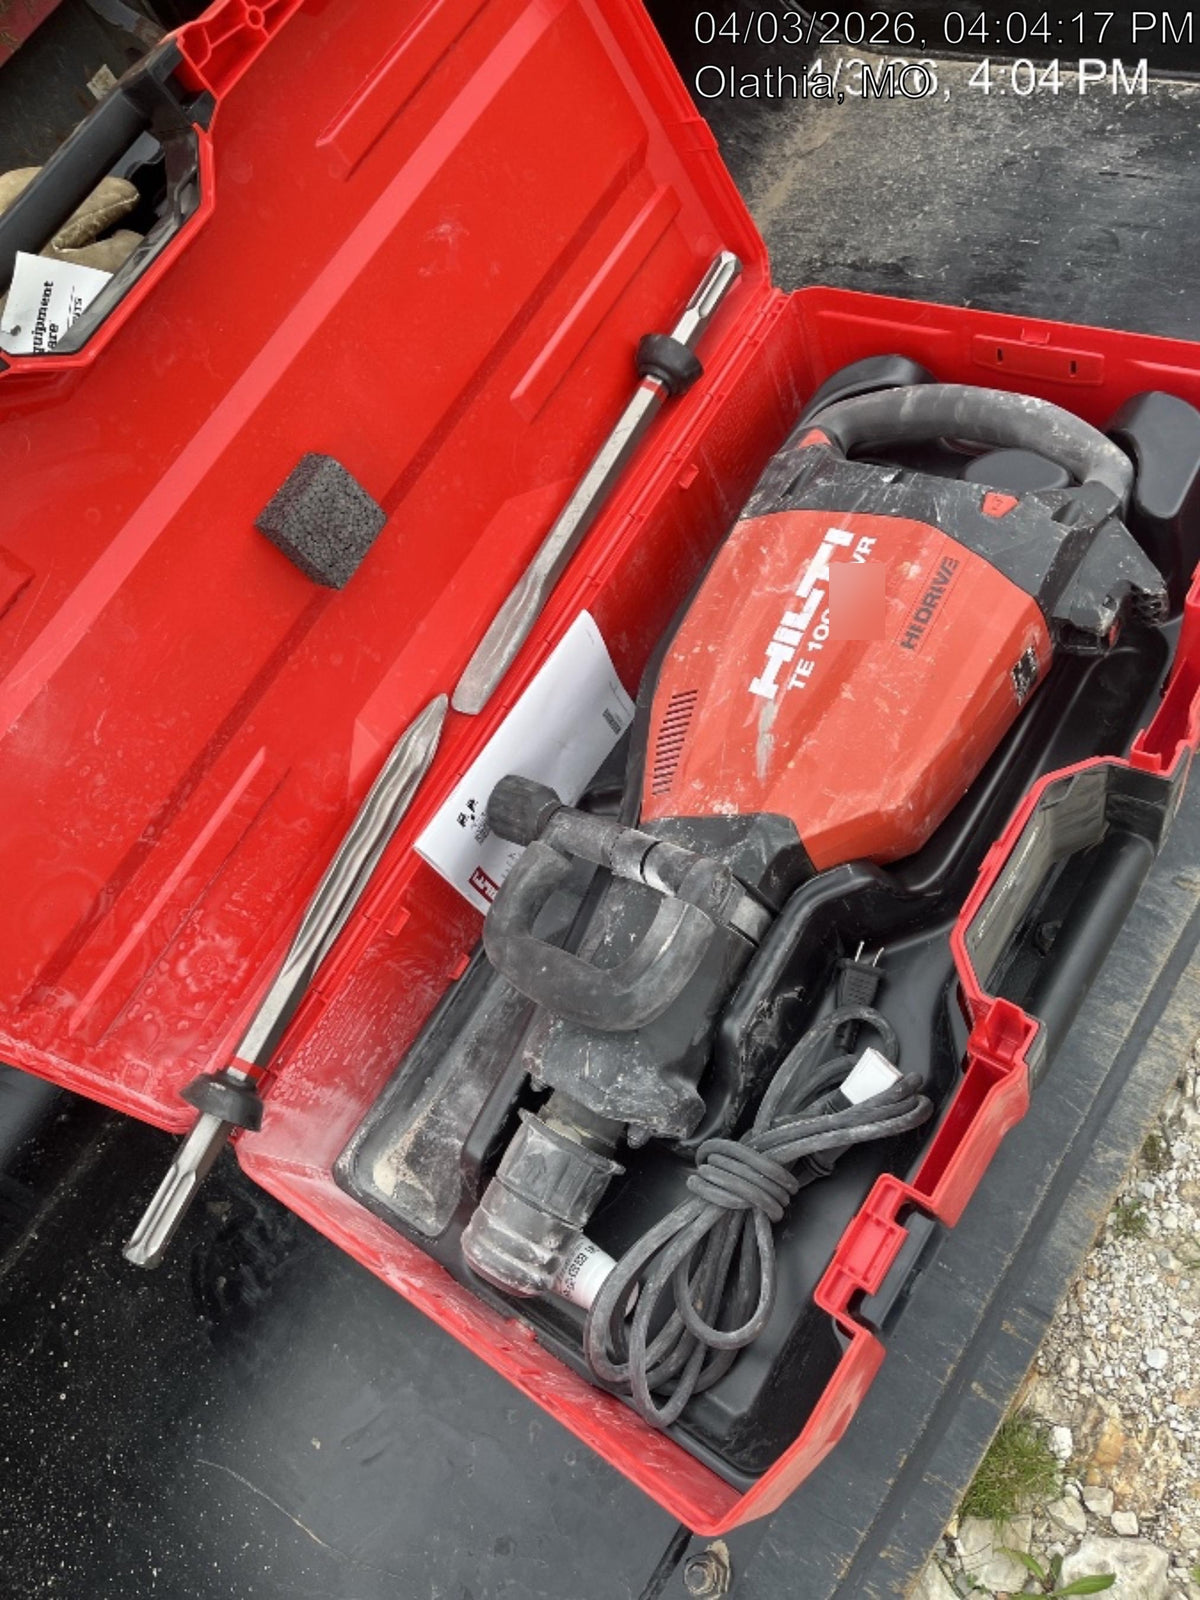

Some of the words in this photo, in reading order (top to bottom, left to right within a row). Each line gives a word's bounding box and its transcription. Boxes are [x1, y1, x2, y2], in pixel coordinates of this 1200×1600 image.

[32, 280, 54, 353] quipment
[748, 527, 855, 699] HILTI
[787, 658, 815, 690] TE
